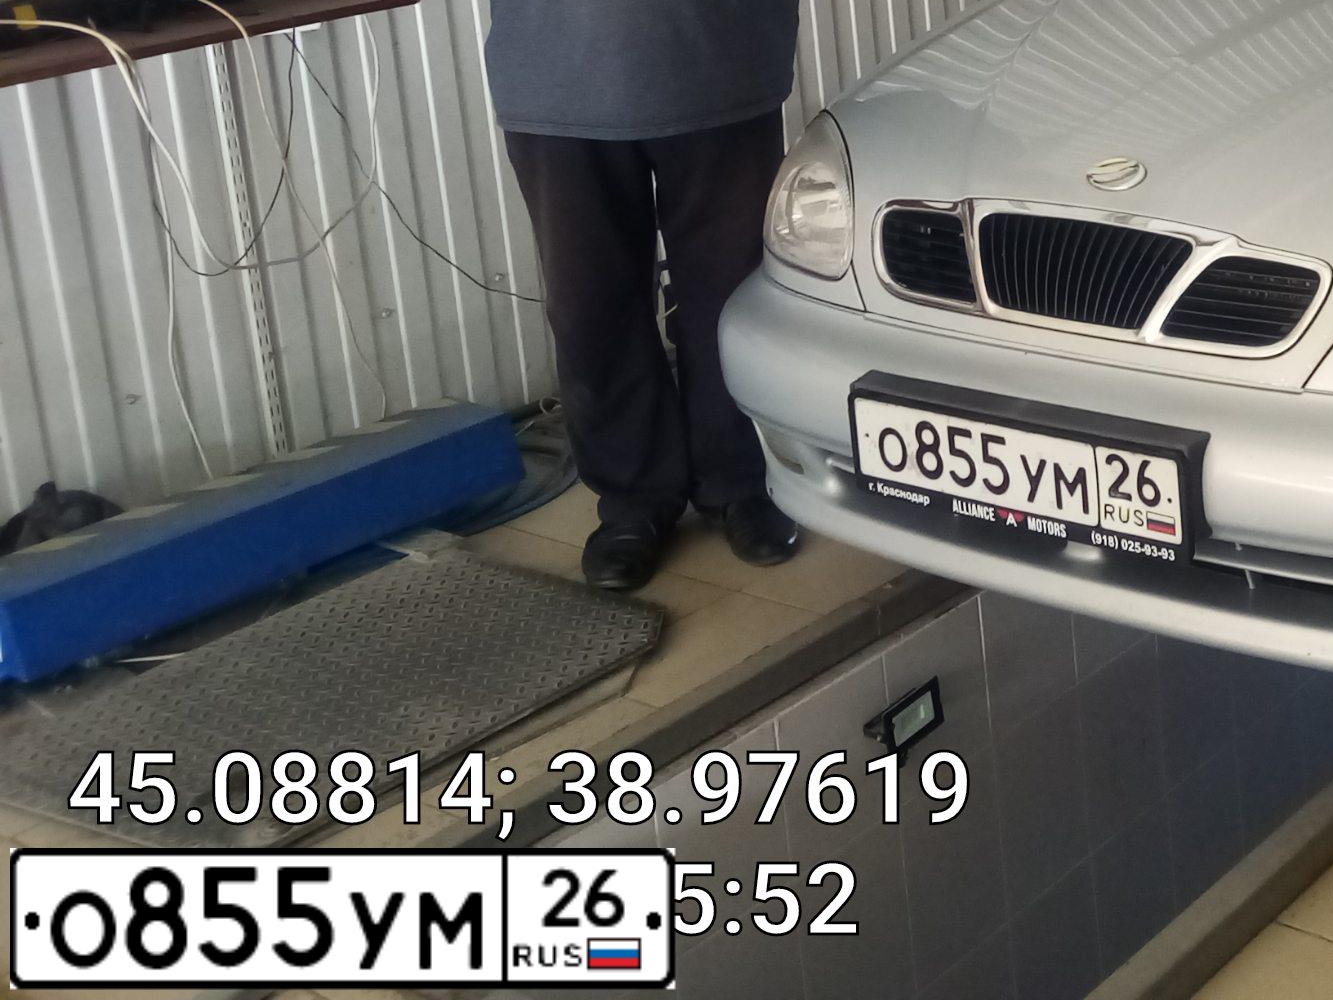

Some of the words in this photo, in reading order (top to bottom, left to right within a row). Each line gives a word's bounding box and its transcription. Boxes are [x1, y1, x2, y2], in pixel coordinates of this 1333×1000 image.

[877, 481, 931, 507] Краснодар
[1105, 453, 1162, 507] 26
[952, 498, 996, 522] ALLIANCE
[1026, 516, 1067, 539] MOTORS
[1103, 503, 1144, 528] RUS
[1090, 530, 1119, 550] (918)
[1120, 540, 1176, 562] 025-93-93
